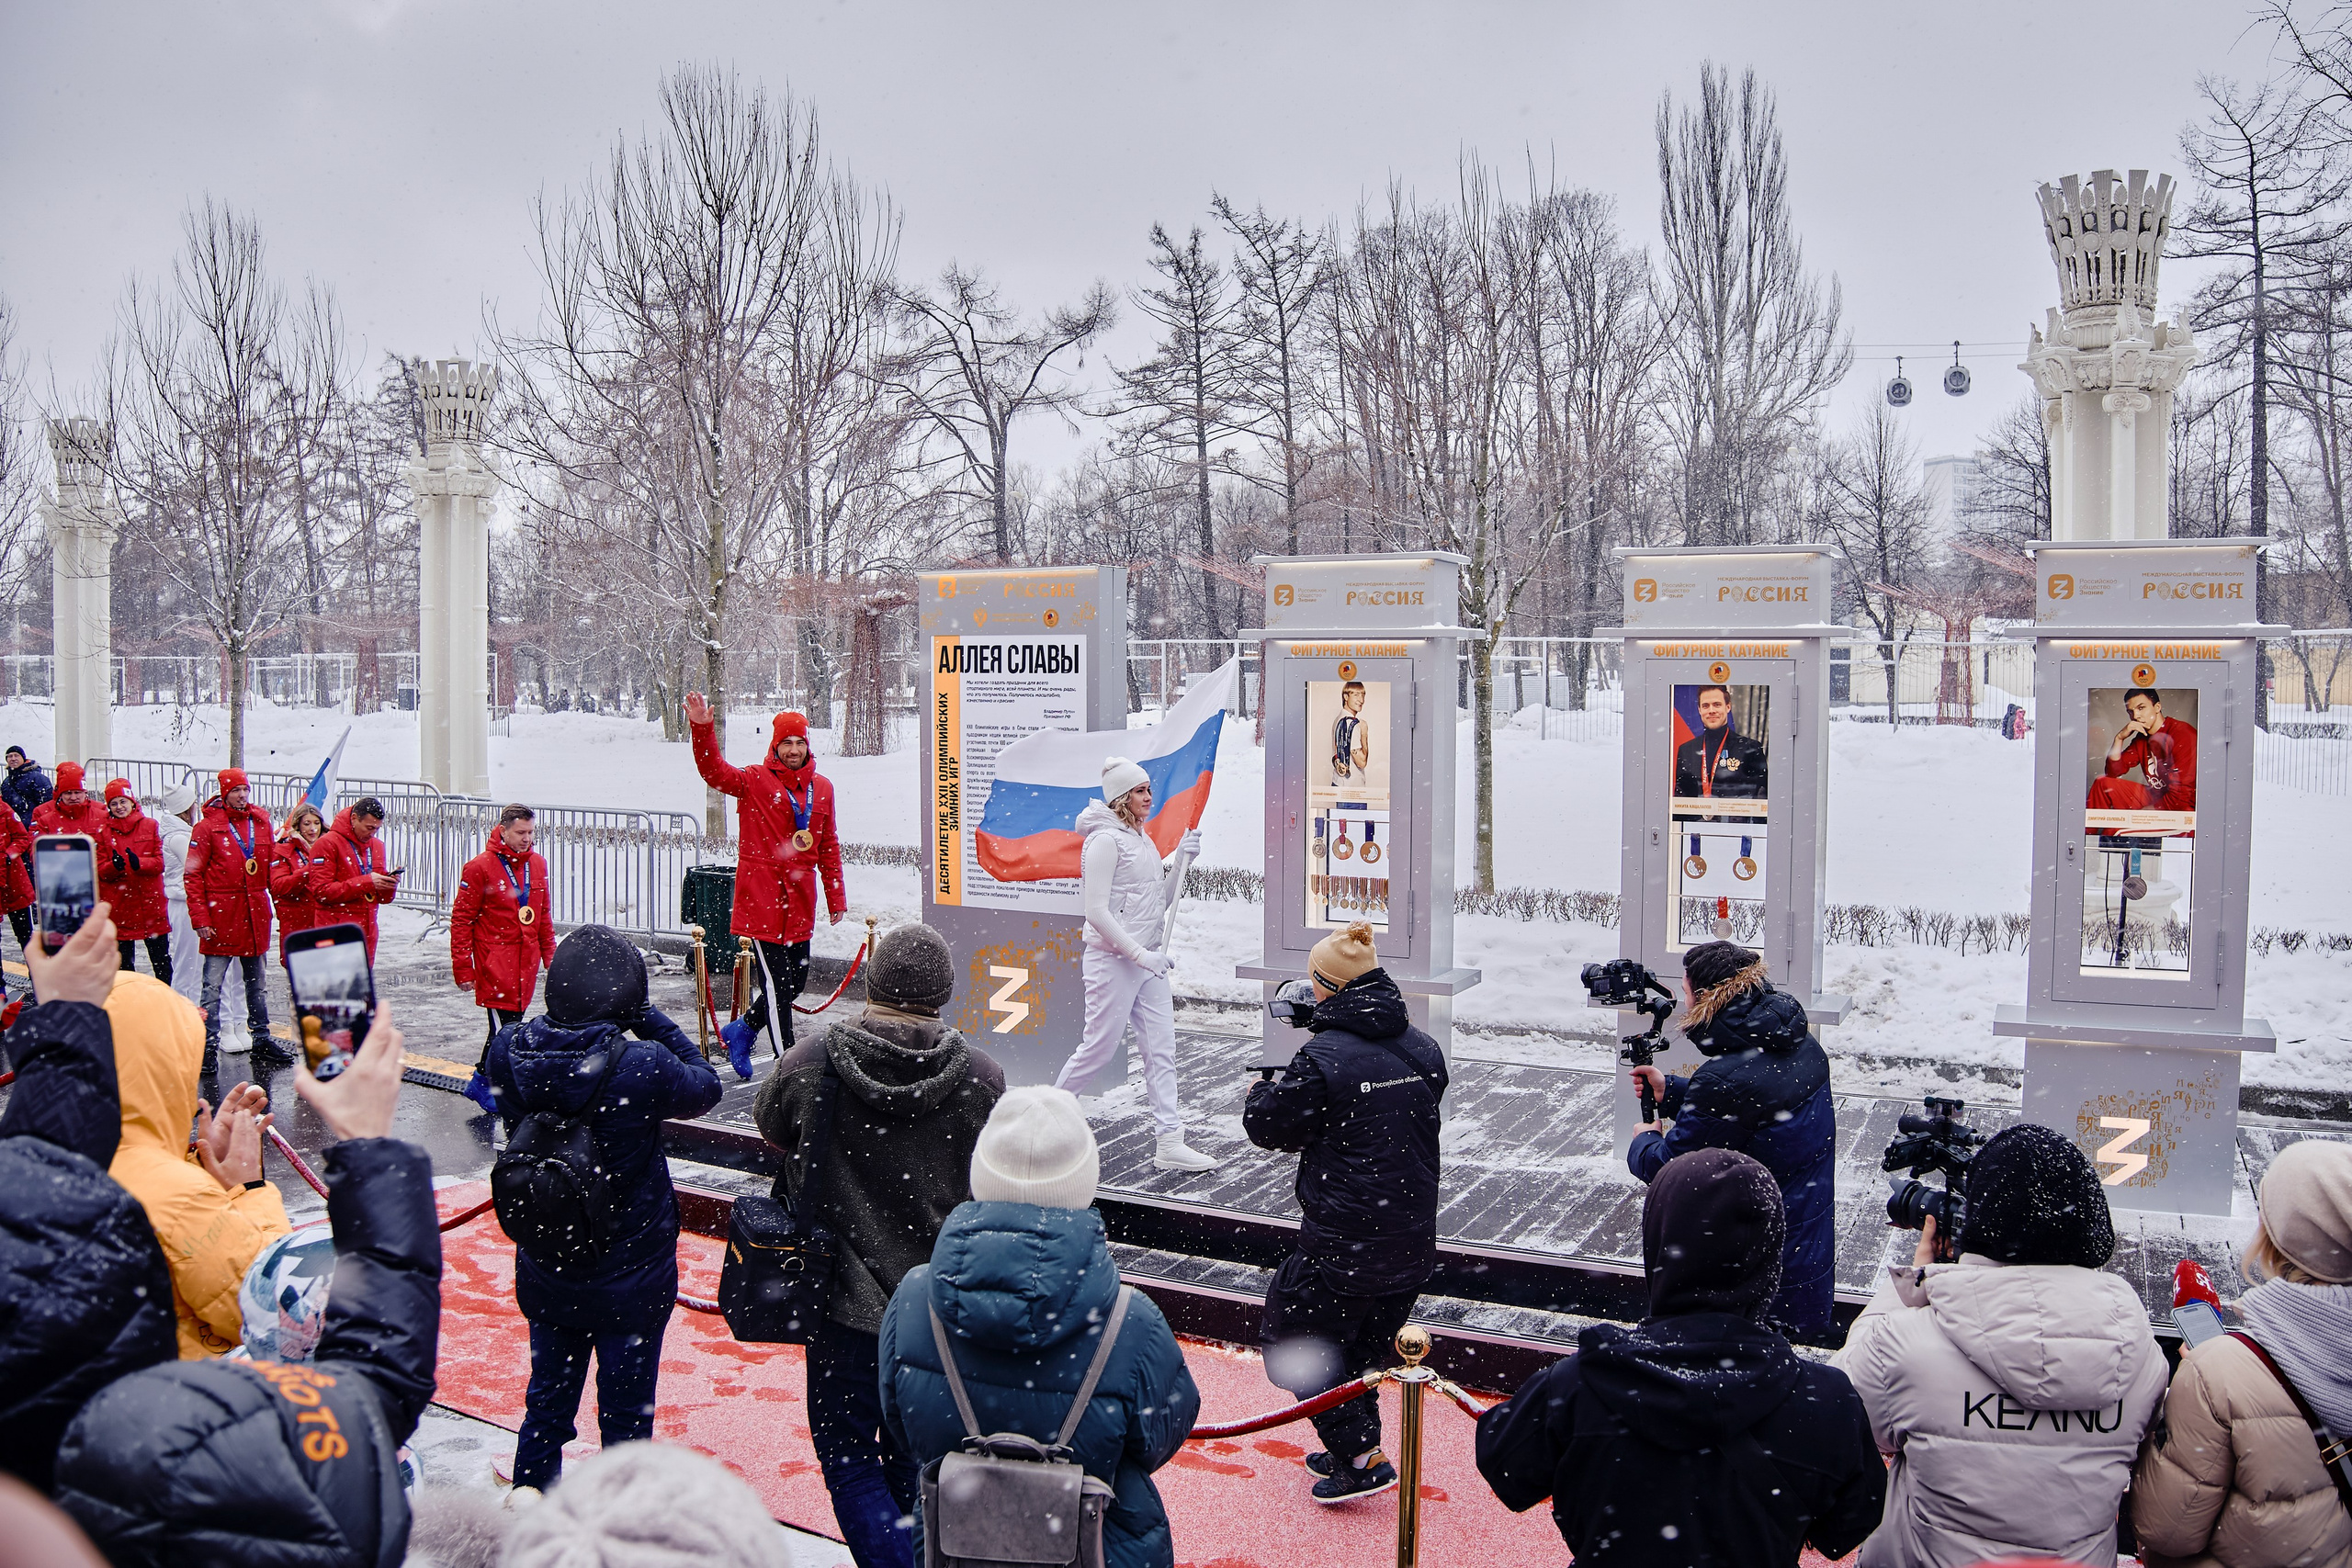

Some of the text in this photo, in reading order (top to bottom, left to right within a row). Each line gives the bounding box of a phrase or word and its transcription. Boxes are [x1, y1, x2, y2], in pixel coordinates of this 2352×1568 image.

[1346, 590, 1425, 606] РОССИЯ
[1717, 586, 1809, 603] РОССИЯ
[2142, 581, 2244, 600] РОССИЯ
[938, 644, 1080, 674] АЛЛЕЯ СЛАВЫ
[1290, 644, 1408, 657] ФИГУРНОЕ КАТАНИЕ
[1654, 643, 1789, 658] ФИГУРНОЕ КАТАНИЕ
[2069, 644, 2222, 660] ФИГУРНОЕ КАТАНИЕ
[936, 692, 950, 895] ДЕСЯТИЛЕТИЕ XXII ОЛИМПИЙСКИХ
[949, 757, 959, 831] ЗИМНИХ ИГР
[1372, 1077, 1404, 1089] Российское
[1963, 1391, 2123, 1434] KEANU
